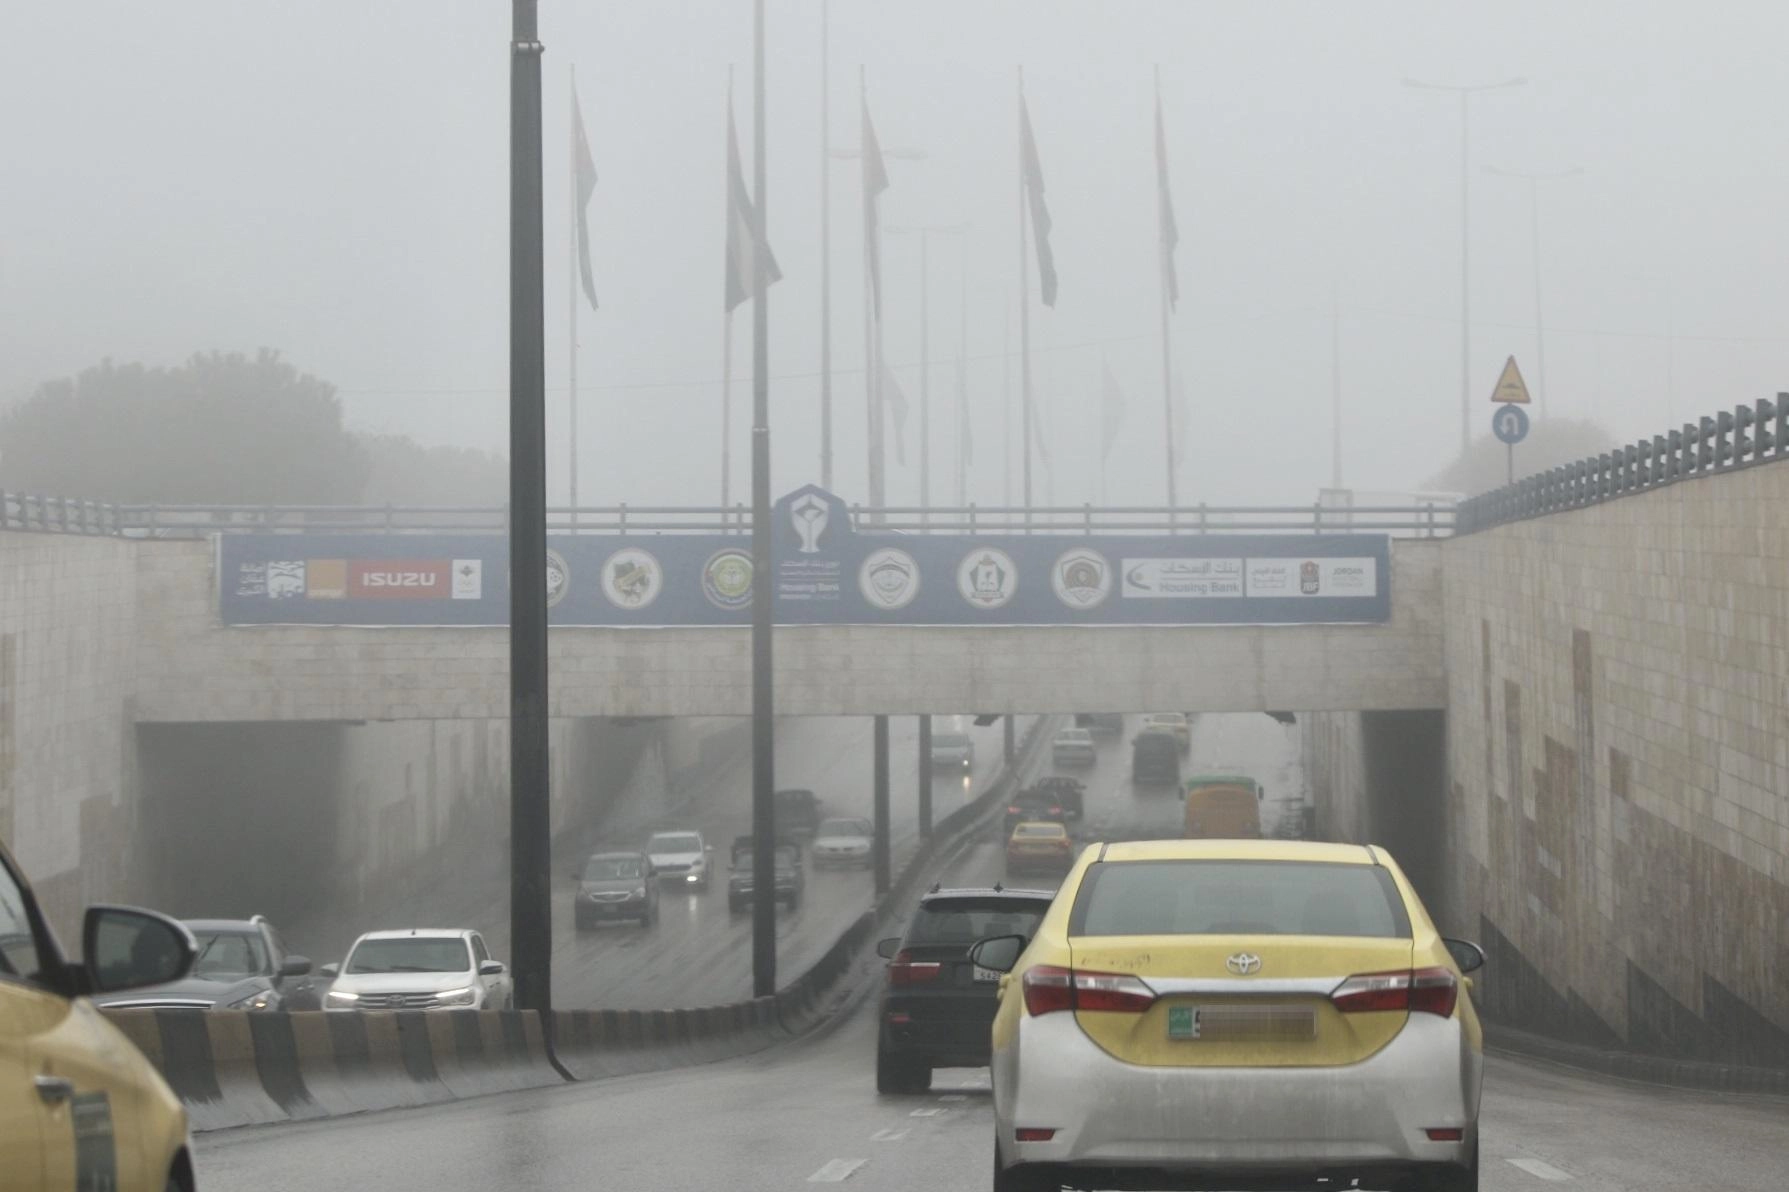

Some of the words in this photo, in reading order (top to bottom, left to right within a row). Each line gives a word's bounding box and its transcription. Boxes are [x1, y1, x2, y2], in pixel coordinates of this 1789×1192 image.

[363, 572, 436, 586] ISUZU
[1160, 583, 1208, 595] Housing
[1211, 583, 1240, 593] Bank
